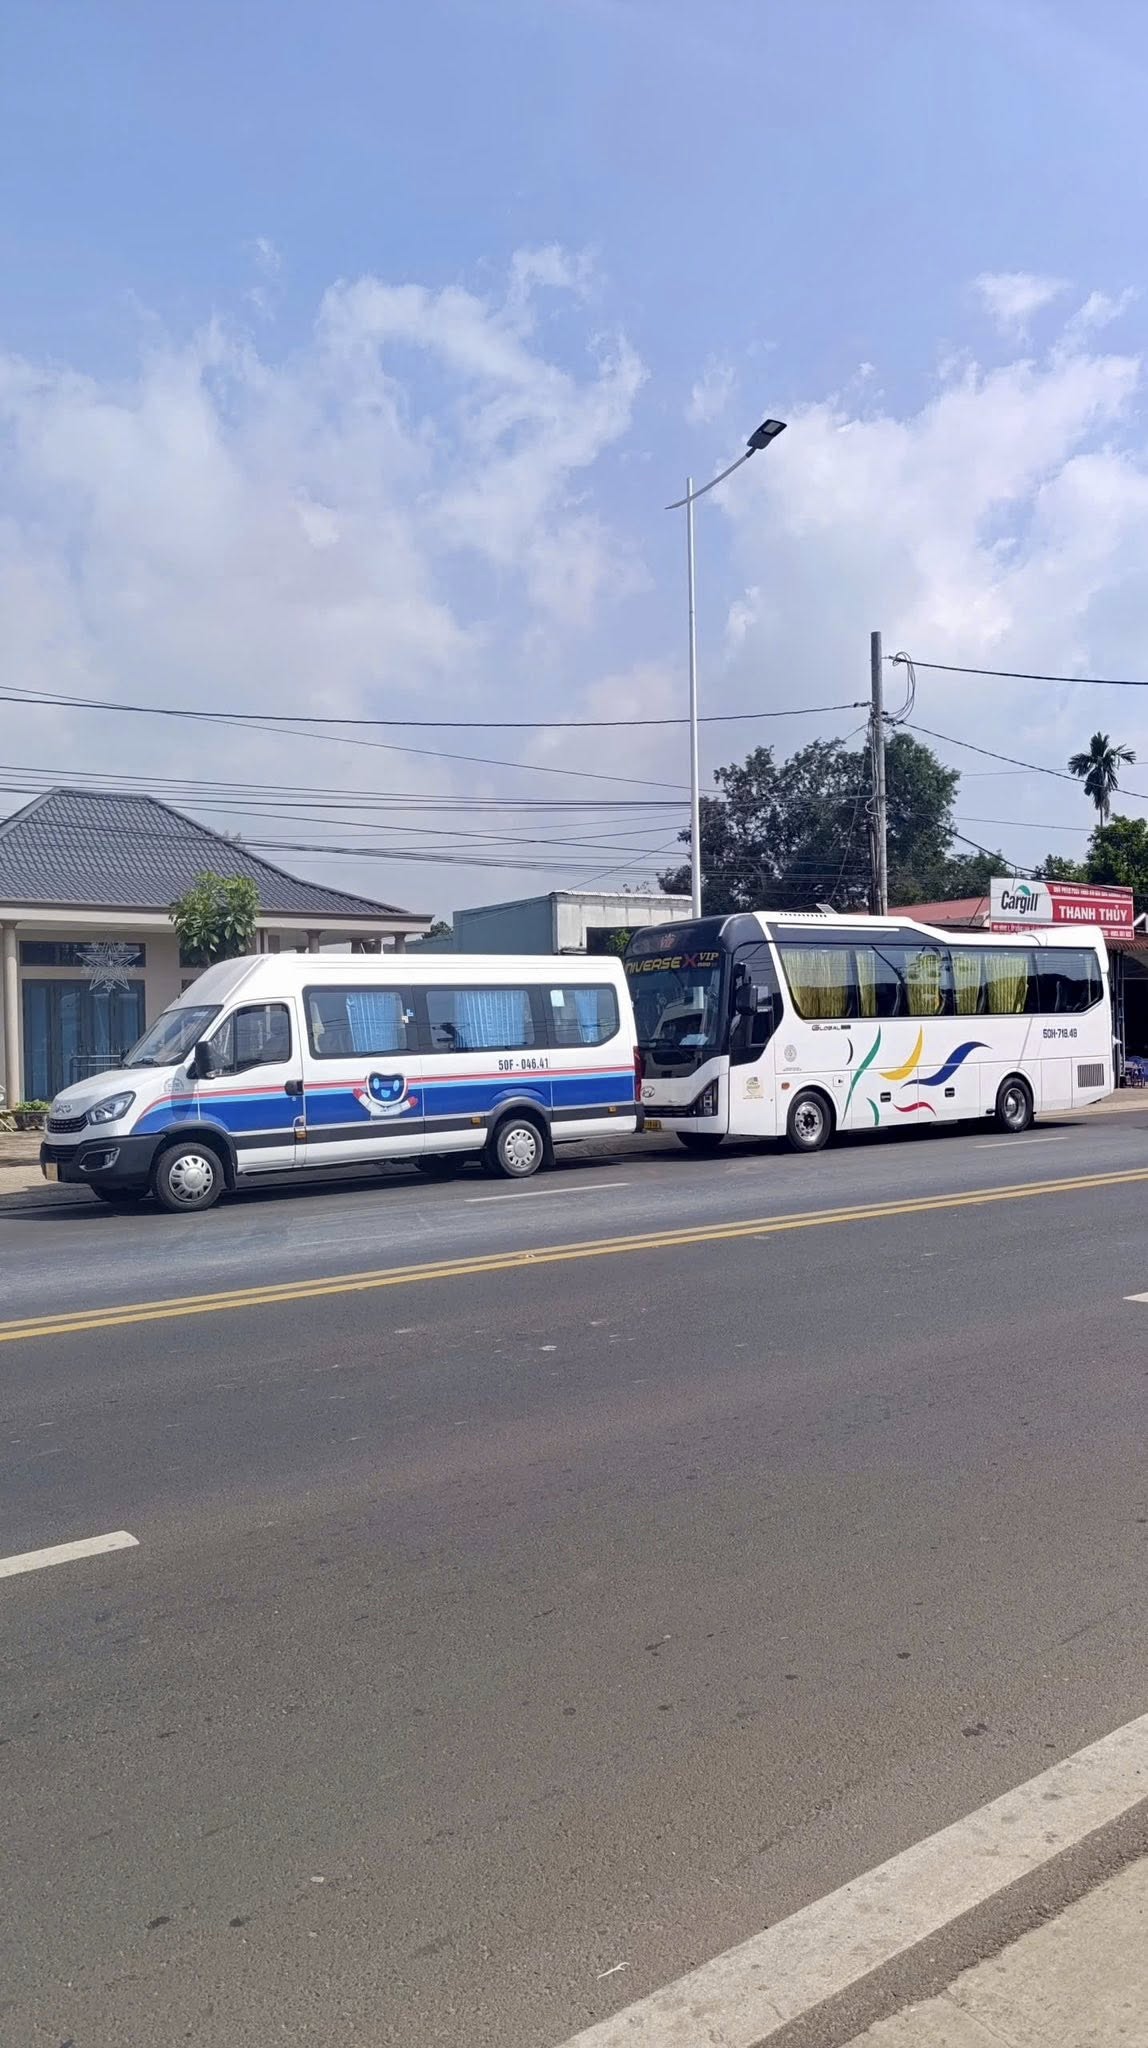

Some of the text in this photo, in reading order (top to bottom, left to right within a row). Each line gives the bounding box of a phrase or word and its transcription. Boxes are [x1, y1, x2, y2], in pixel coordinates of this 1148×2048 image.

[1001, 890, 1039, 914] Cargill
[1059, 905, 1128, 921] THANH THỦY
[625, 956, 682, 974] NIVERSE
[699, 952, 719, 961] VIP
[498, 1059, 513, 1071] 50F
[521, 1057, 549, 1069] 046.41
